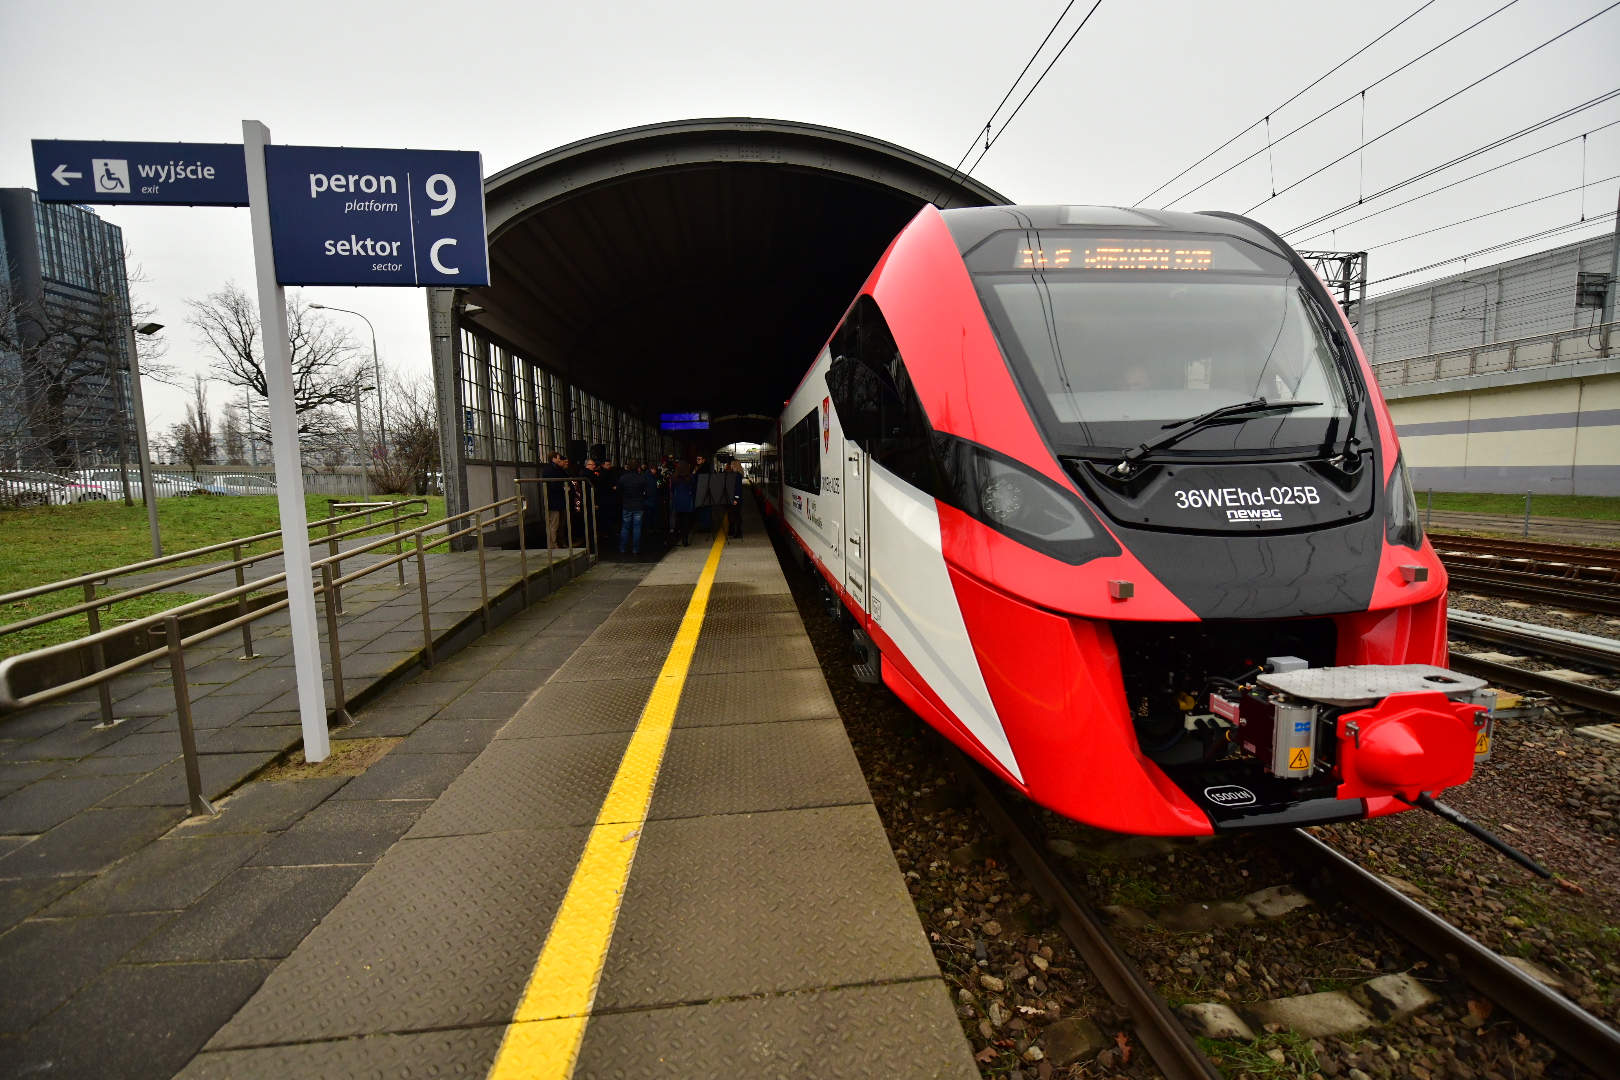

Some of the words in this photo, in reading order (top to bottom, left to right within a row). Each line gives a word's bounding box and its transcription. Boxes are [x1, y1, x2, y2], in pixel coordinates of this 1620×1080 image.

[138, 161, 216, 182] wyjście
[141, 184, 160, 195] exit
[309, 172, 397, 198] peron
[425, 173, 457, 217] 9
[344, 198, 398, 214] platform
[324, 234, 401, 257] sektor
[429, 237, 460, 275] C
[371, 262, 403, 272] sector
[1174, 486, 1320, 509] 36WEhd-025B
